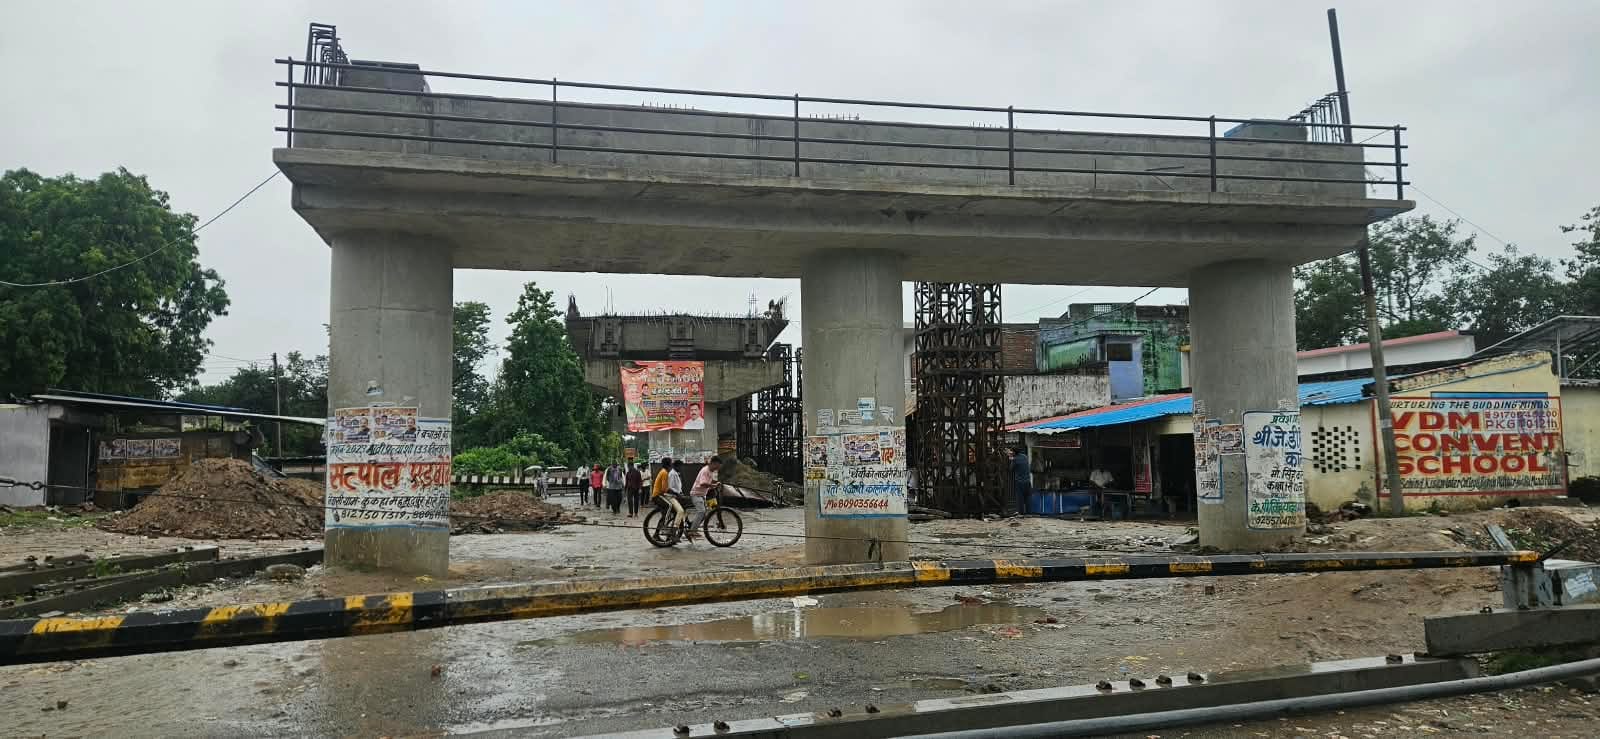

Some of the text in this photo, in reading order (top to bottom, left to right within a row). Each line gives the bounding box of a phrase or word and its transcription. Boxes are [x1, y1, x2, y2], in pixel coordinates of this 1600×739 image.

[1391, 400, 1549, 409] URTURING THE BUDDING MINDS
[1391, 411, 1480, 430] VDM
[1485, 419, 1515, 429] PKG
[1393, 433, 1558, 452] CONVENT
[1397, 454, 1548, 474] SCHOOL
